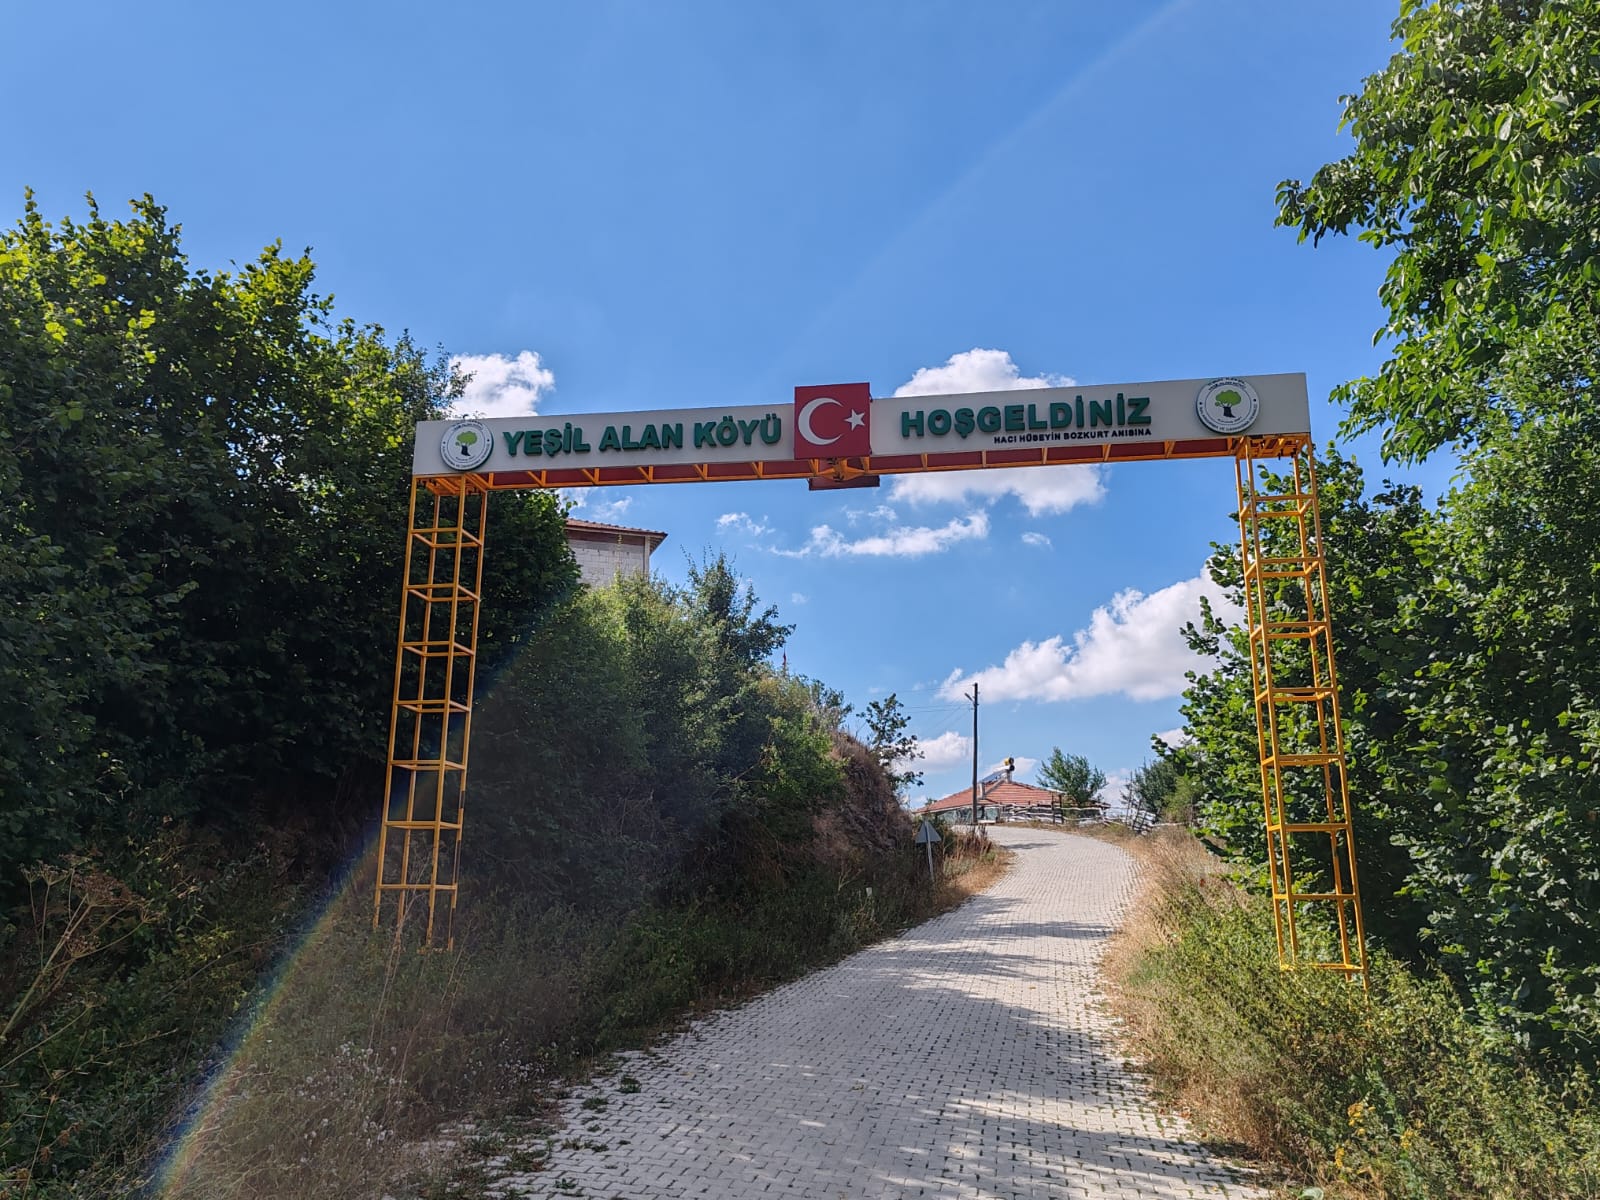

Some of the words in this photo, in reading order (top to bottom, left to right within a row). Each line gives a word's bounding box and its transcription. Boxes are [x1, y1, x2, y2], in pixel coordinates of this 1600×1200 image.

[502, 422, 591, 456] YEŞİL
[599, 424, 684, 452] ALAN
[694, 413, 782, 449] KÖYÜ
[901, 393, 1152, 440] HOŞGELDİNİZ
[994, 435, 1017, 444] HACI
[1063, 430, 1110, 441] BOZKURT
